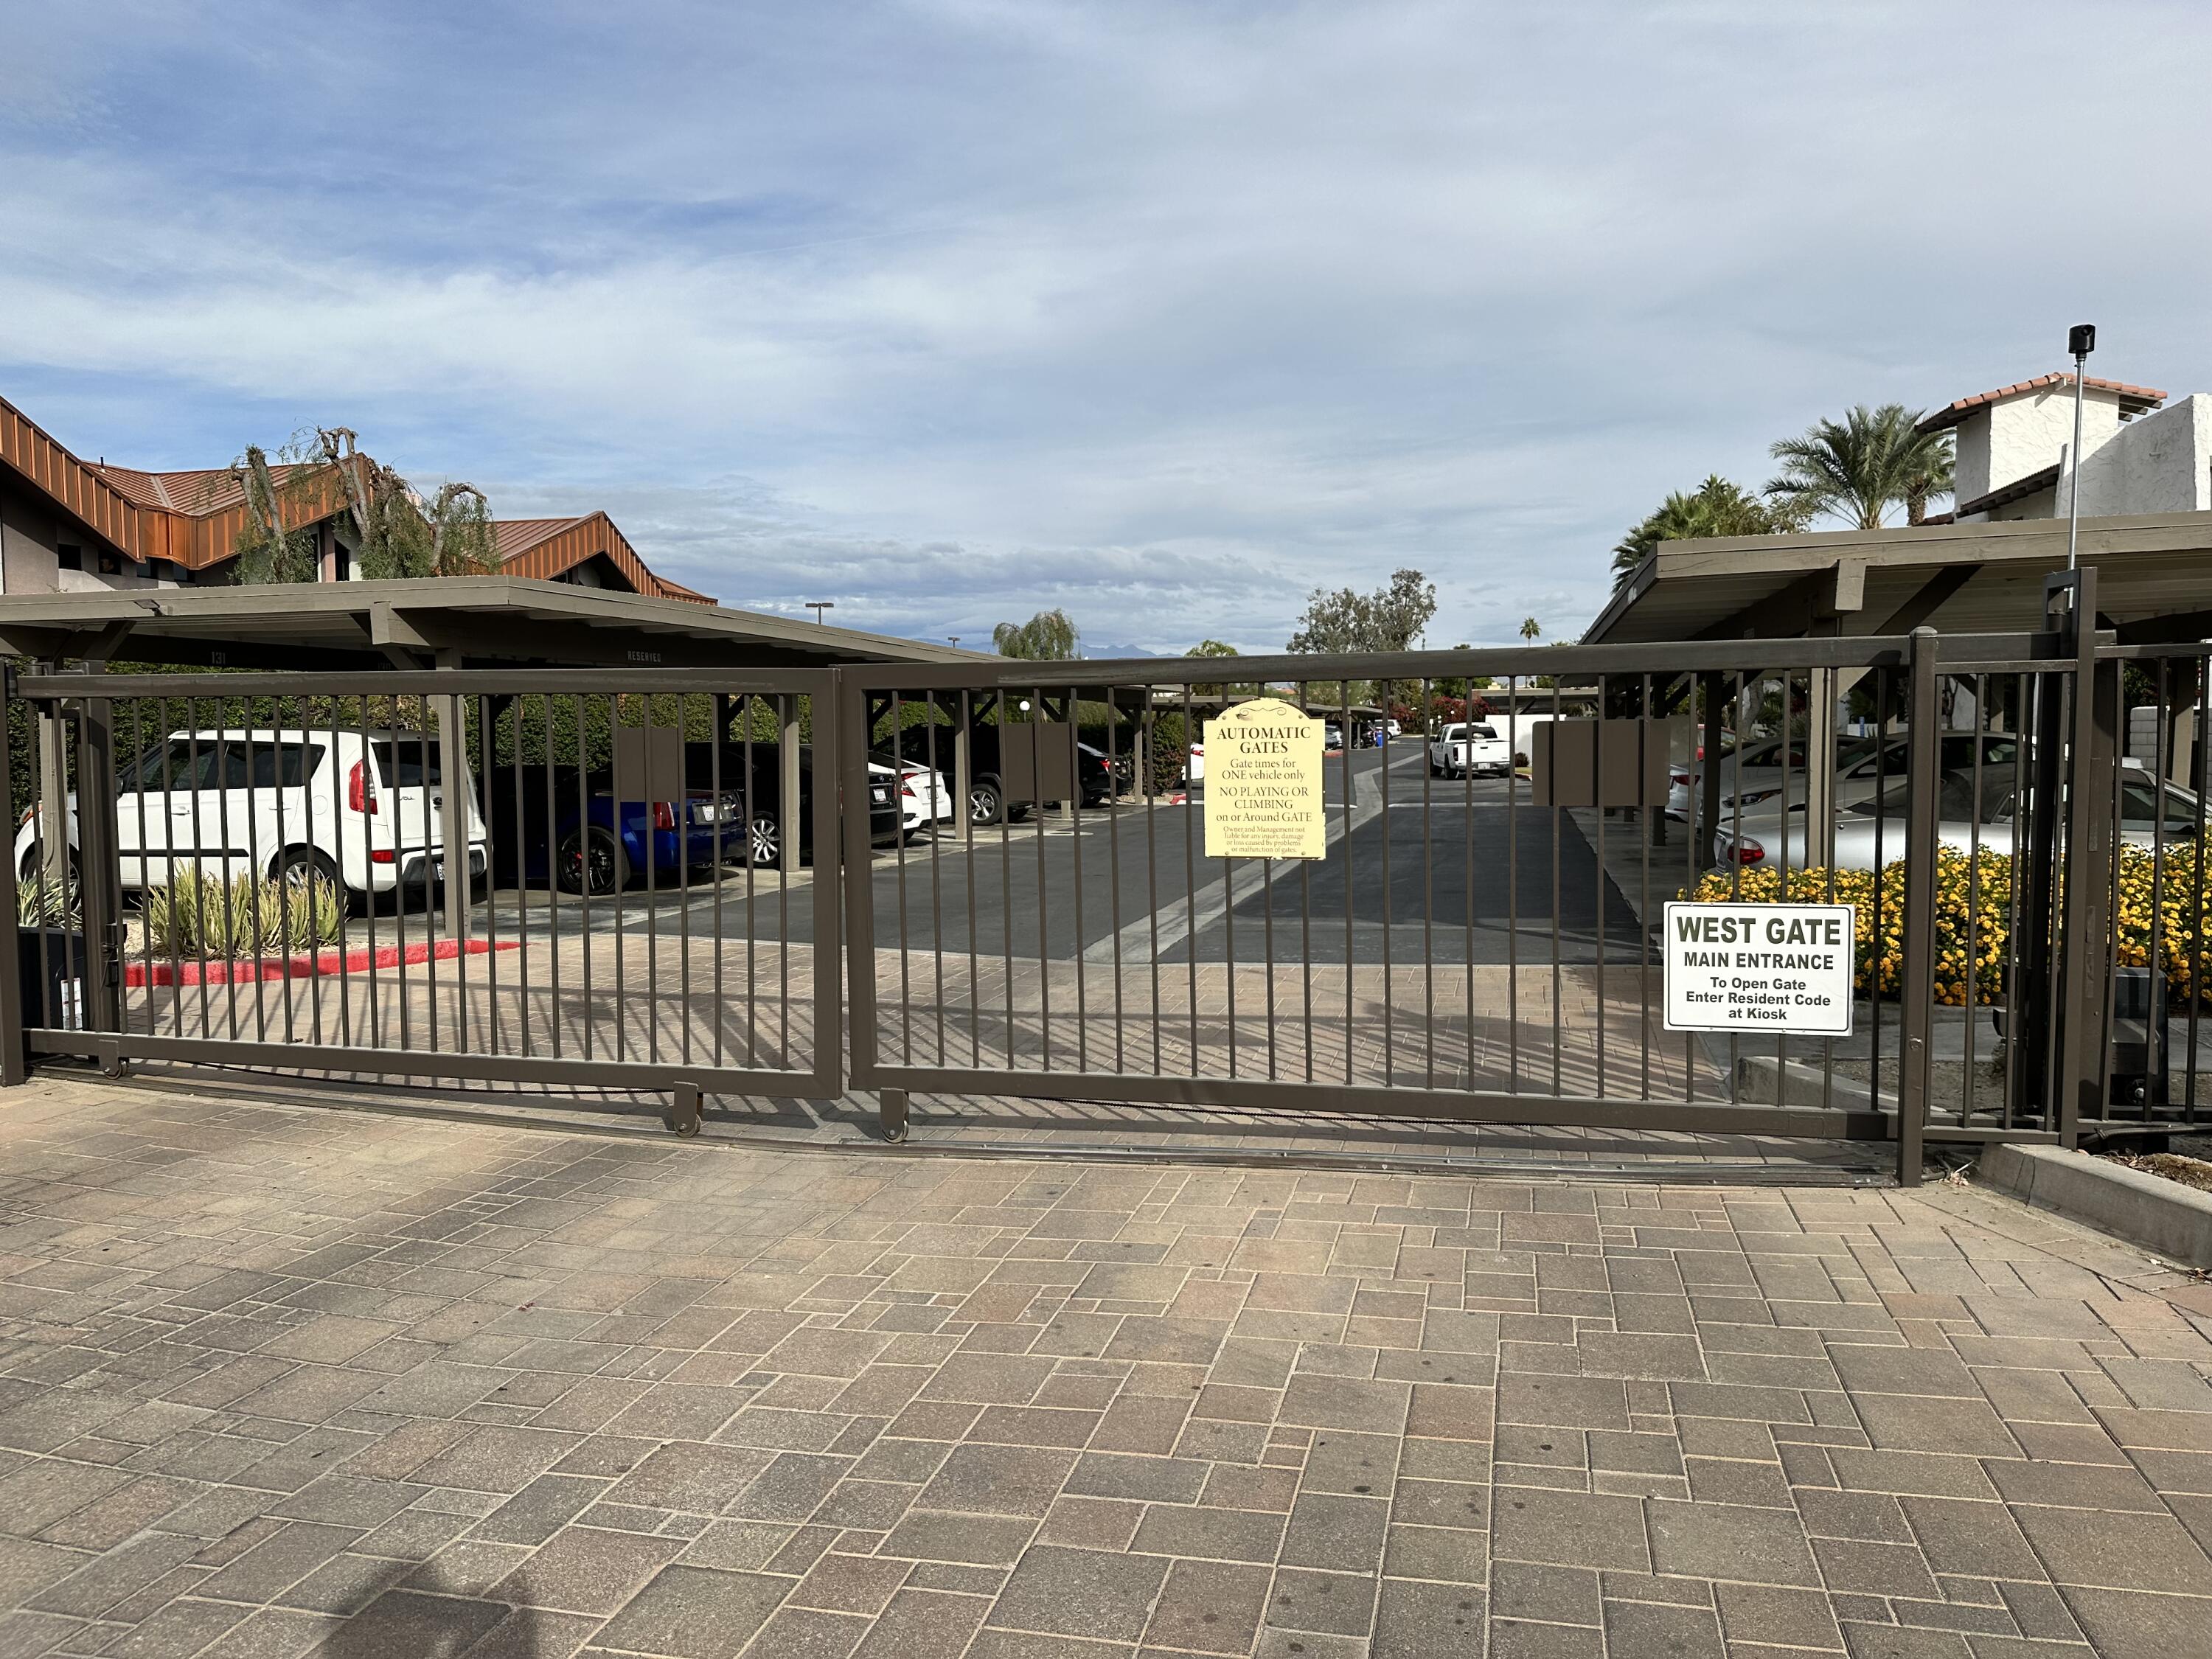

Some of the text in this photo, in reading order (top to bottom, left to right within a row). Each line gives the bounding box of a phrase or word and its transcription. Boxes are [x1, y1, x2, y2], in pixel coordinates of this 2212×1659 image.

[212, 651, 226, 664] 131
[627, 650, 661, 662] RESERVED
[1217, 726, 1311, 740] AUTOMATIC
[1239, 742, 1288, 754] GATES
[1230, 757, 1296, 768] Gate times for
[1222, 769, 1305, 782] ONE vehicle only
[1220, 787, 1309, 796] NO PLAYING OR
[1234, 799, 1293, 809] CLIMBING
[1242, 812, 1279, 821] Around
[1281, 812, 1312, 821] GATE
[1256, 826, 1294, 834] Management
[1676, 916, 1841, 945] WEST GATE
[1684, 951, 1834, 970] MAIN ENTRANCE
[1710, 977, 1806, 991] To Open Gate
[1686, 991, 1831, 1006] Enter Resident Code
[1728, 1008, 1787, 1020] at Kiosk
